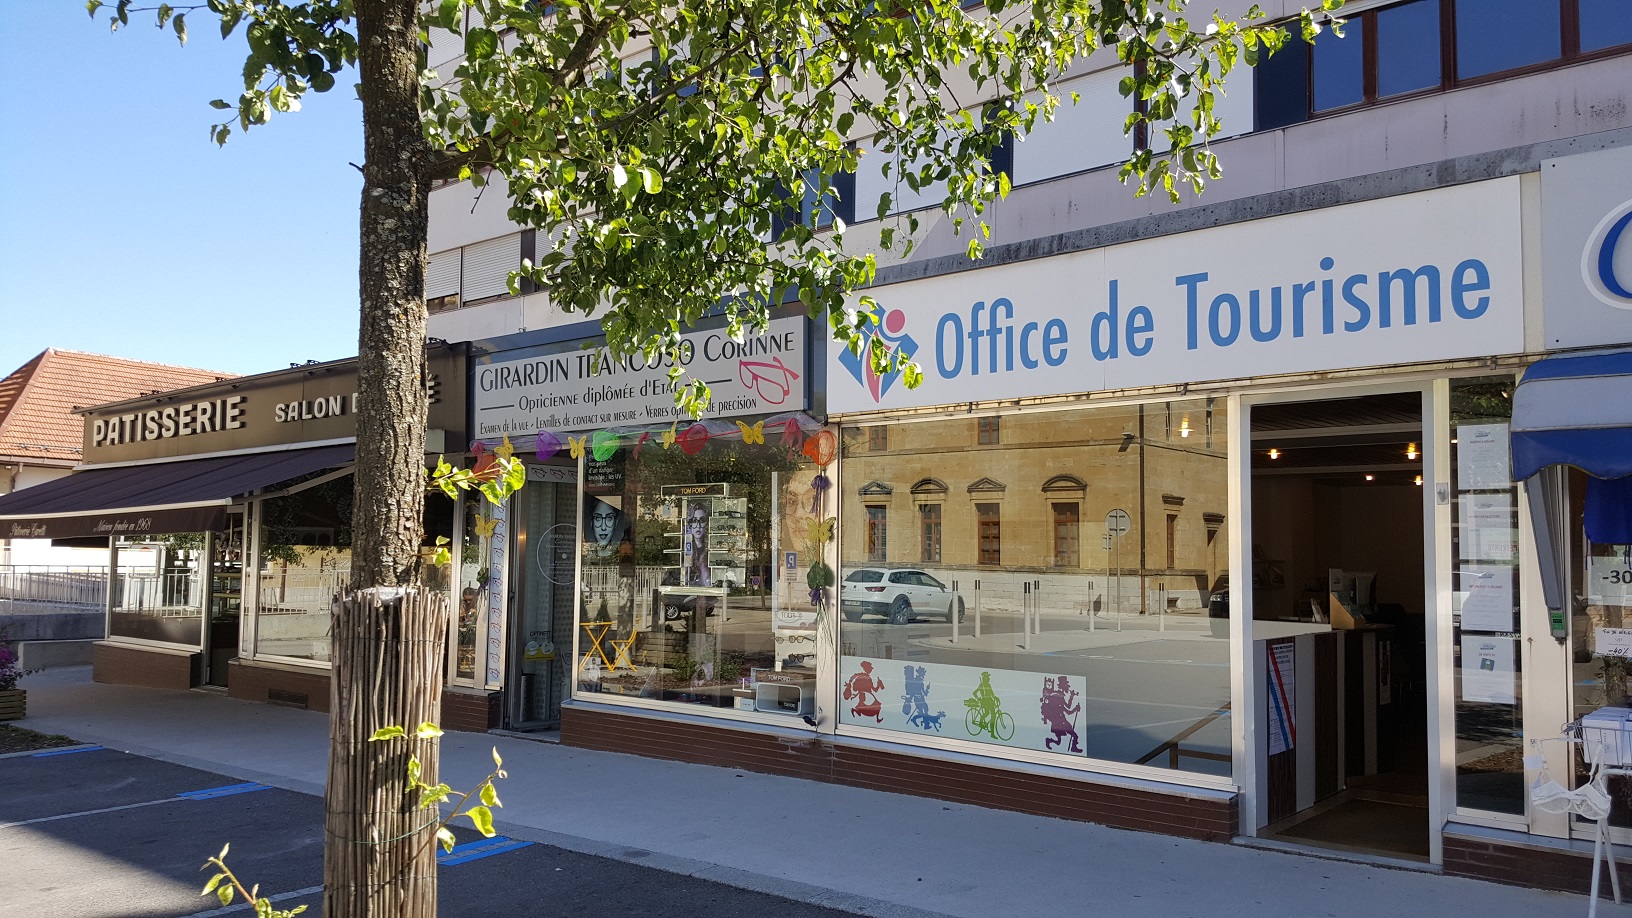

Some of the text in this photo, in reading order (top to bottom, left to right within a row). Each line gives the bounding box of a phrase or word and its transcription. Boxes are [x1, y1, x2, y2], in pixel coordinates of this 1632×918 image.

[935, 256, 1491, 379] Office de Tourisme
[480, 357, 569, 392] GIRARDIN
[92, 395, 243, 447] PATISSERIE
[274, 394, 342, 423] SALON
[680, 486, 707, 495] TOM FORD
